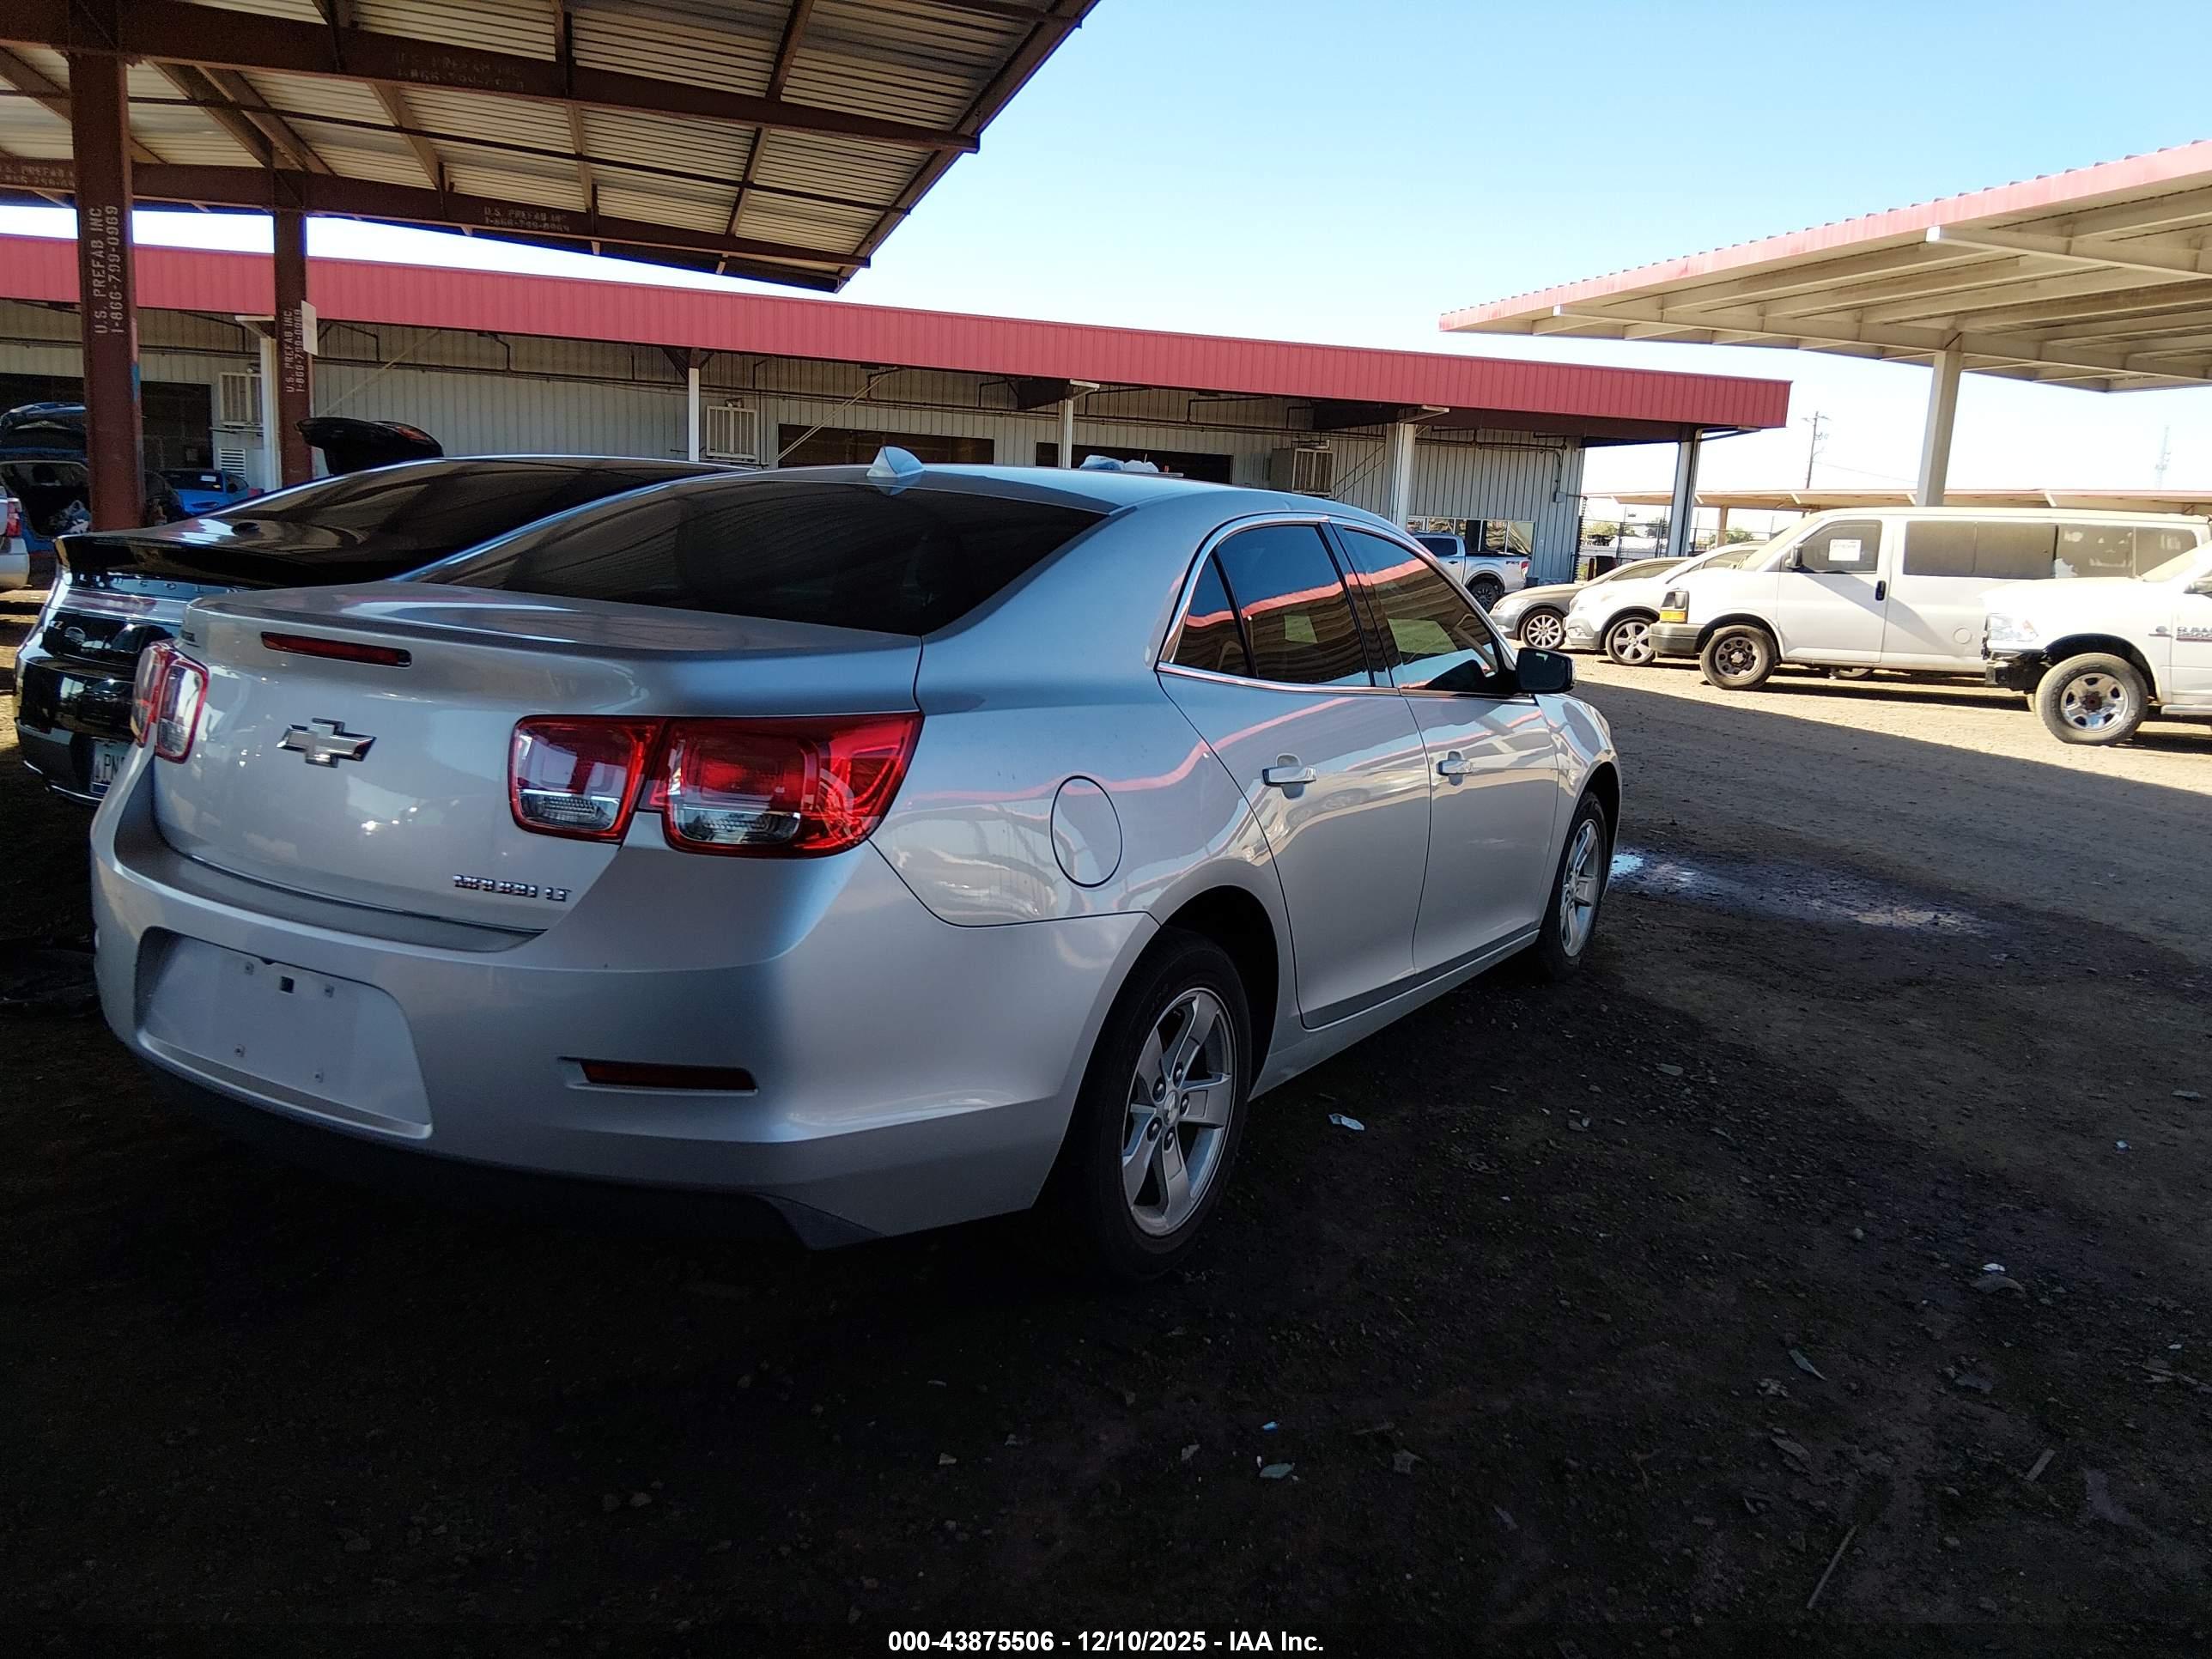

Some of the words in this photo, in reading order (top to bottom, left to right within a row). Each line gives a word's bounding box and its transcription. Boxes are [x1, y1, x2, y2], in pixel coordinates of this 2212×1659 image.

[88, 207, 105, 232] INC
[90, 239, 106, 297] PREFAB
[105, 205, 125, 334] 1-866-799-0969
[94, 305, 108, 335] U.S.
[283, 330, 295, 369] PREFAB
